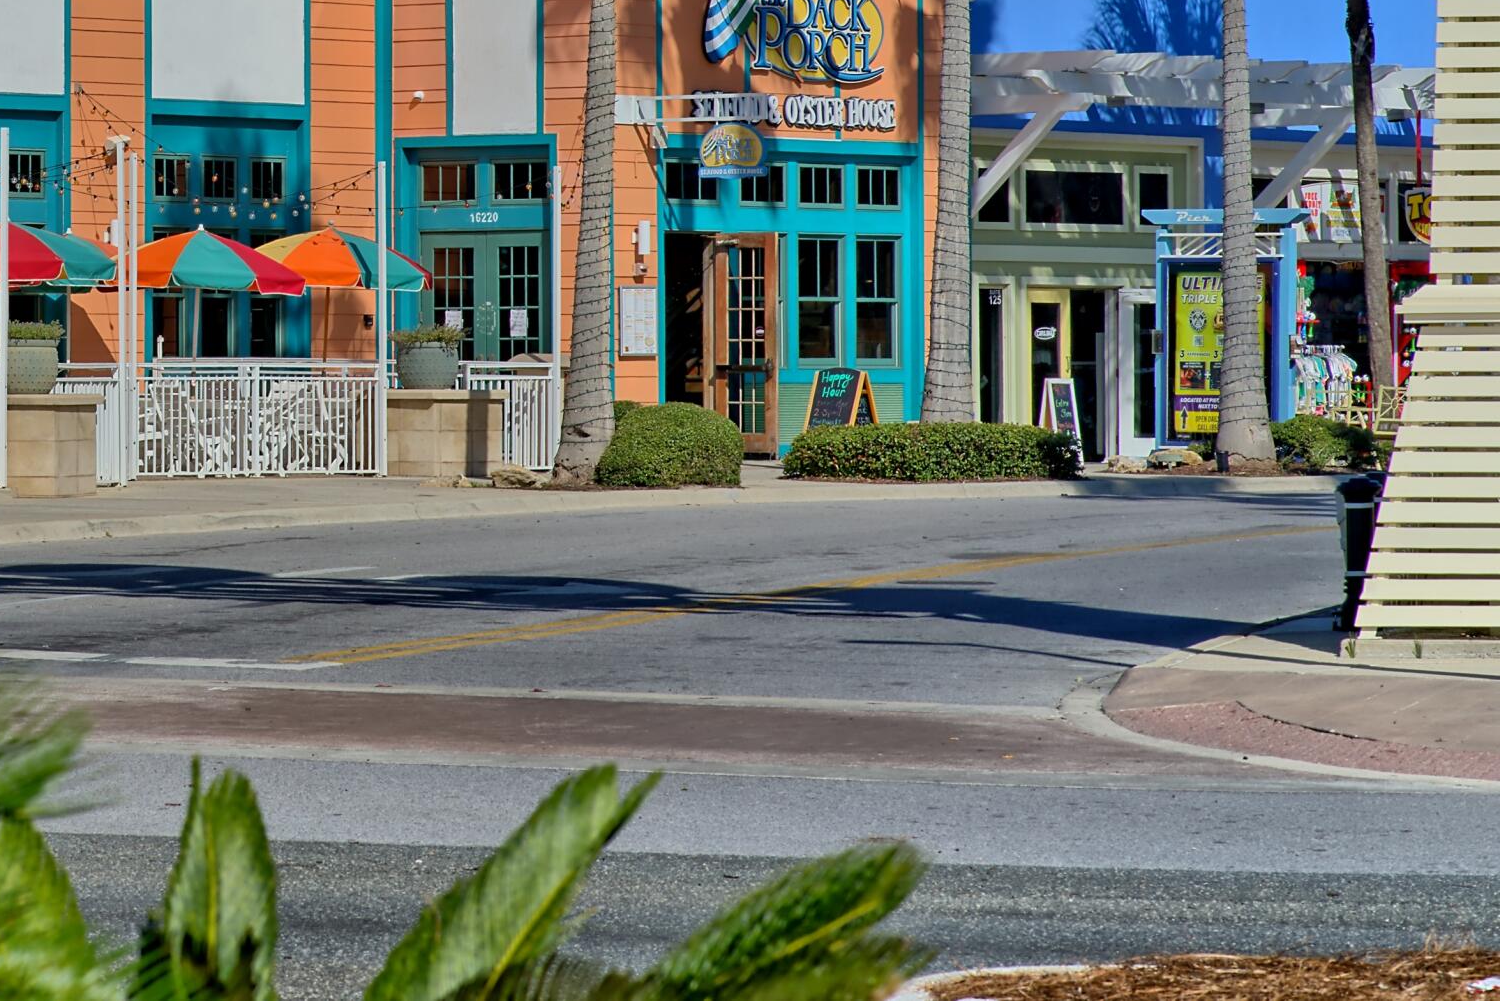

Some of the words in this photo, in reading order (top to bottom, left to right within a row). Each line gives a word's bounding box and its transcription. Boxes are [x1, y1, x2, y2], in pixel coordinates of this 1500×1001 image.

[753, 5, 884, 82] PORCH
[768, 95, 782, 126] &
[784, 95, 844, 127] OYSTER
[846, 97, 897, 129] HOUSE
[470, 212, 499, 223] 16220
[988, 295, 1002, 305] 125
[1182, 294, 1217, 304] TRIPLE
[822, 387, 846, 398] Hour
